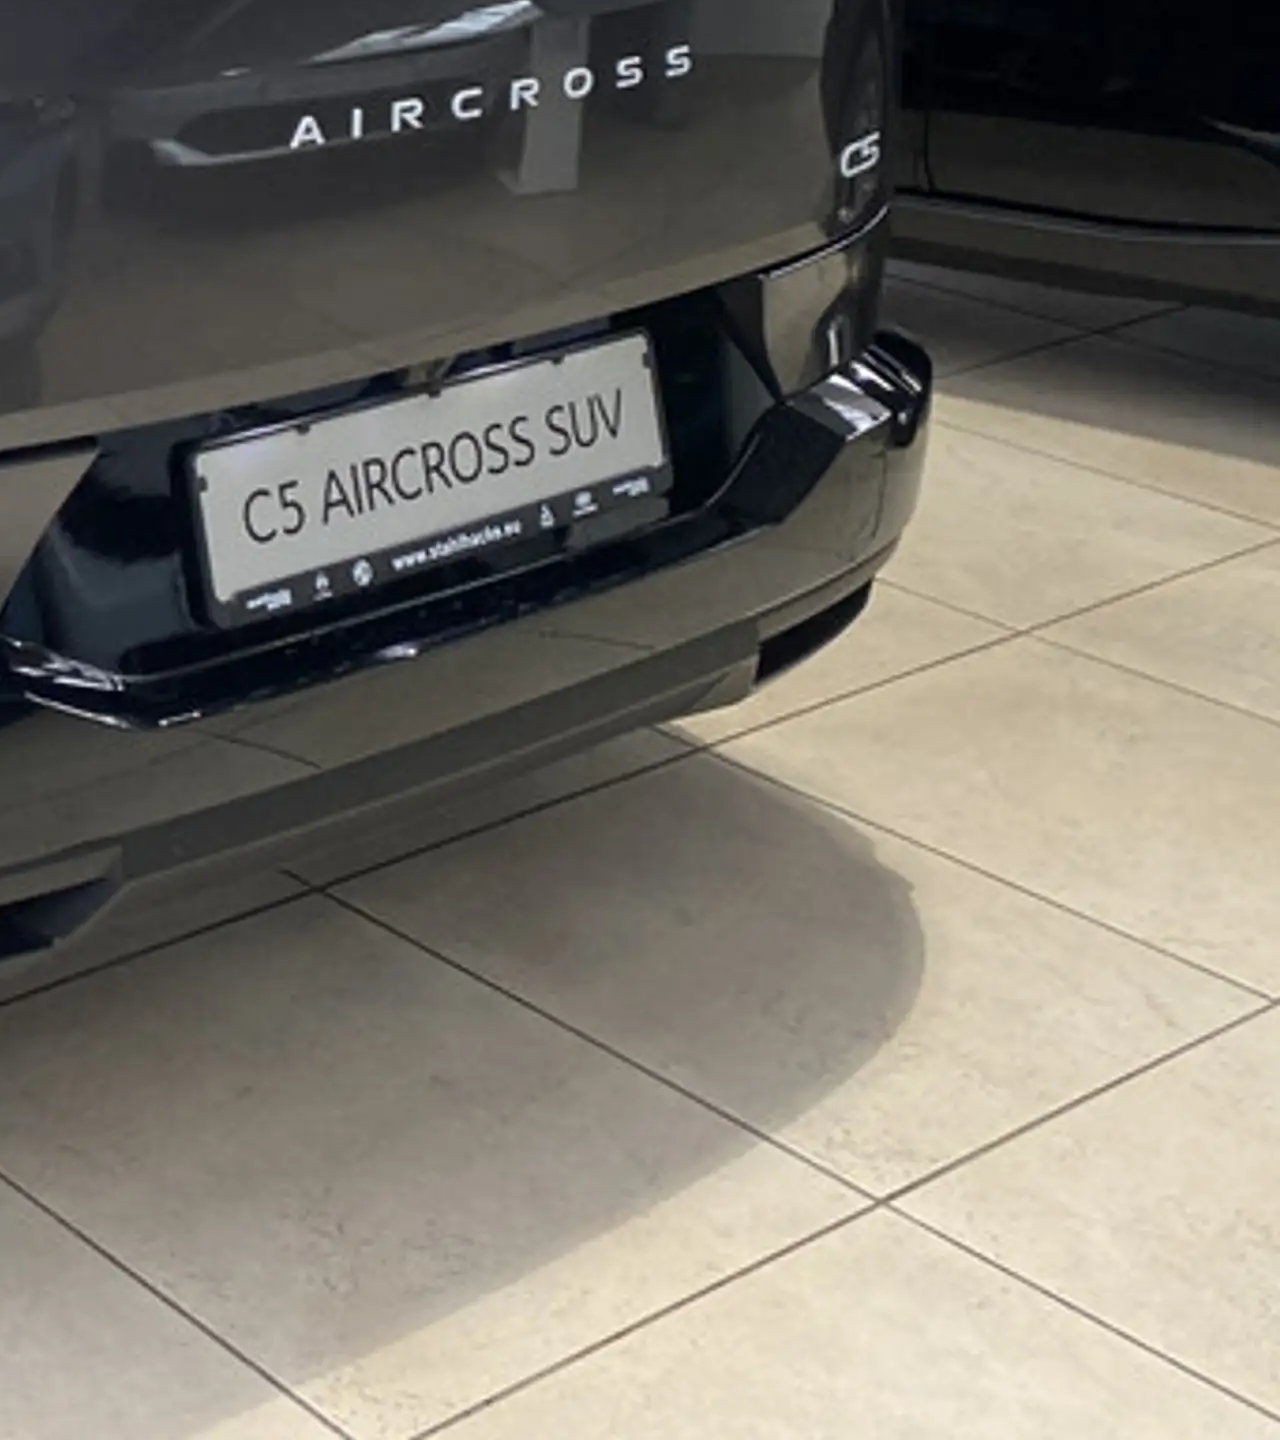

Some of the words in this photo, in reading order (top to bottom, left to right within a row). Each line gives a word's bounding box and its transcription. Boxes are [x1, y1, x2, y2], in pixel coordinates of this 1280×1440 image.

[289, 45, 691, 150] AIRCROSS
[840, 132, 880, 177] C5
[243, 479, 306, 544] C5
[322, 415, 536, 525] AIRCROSS
[544, 387, 623, 457] SUV
